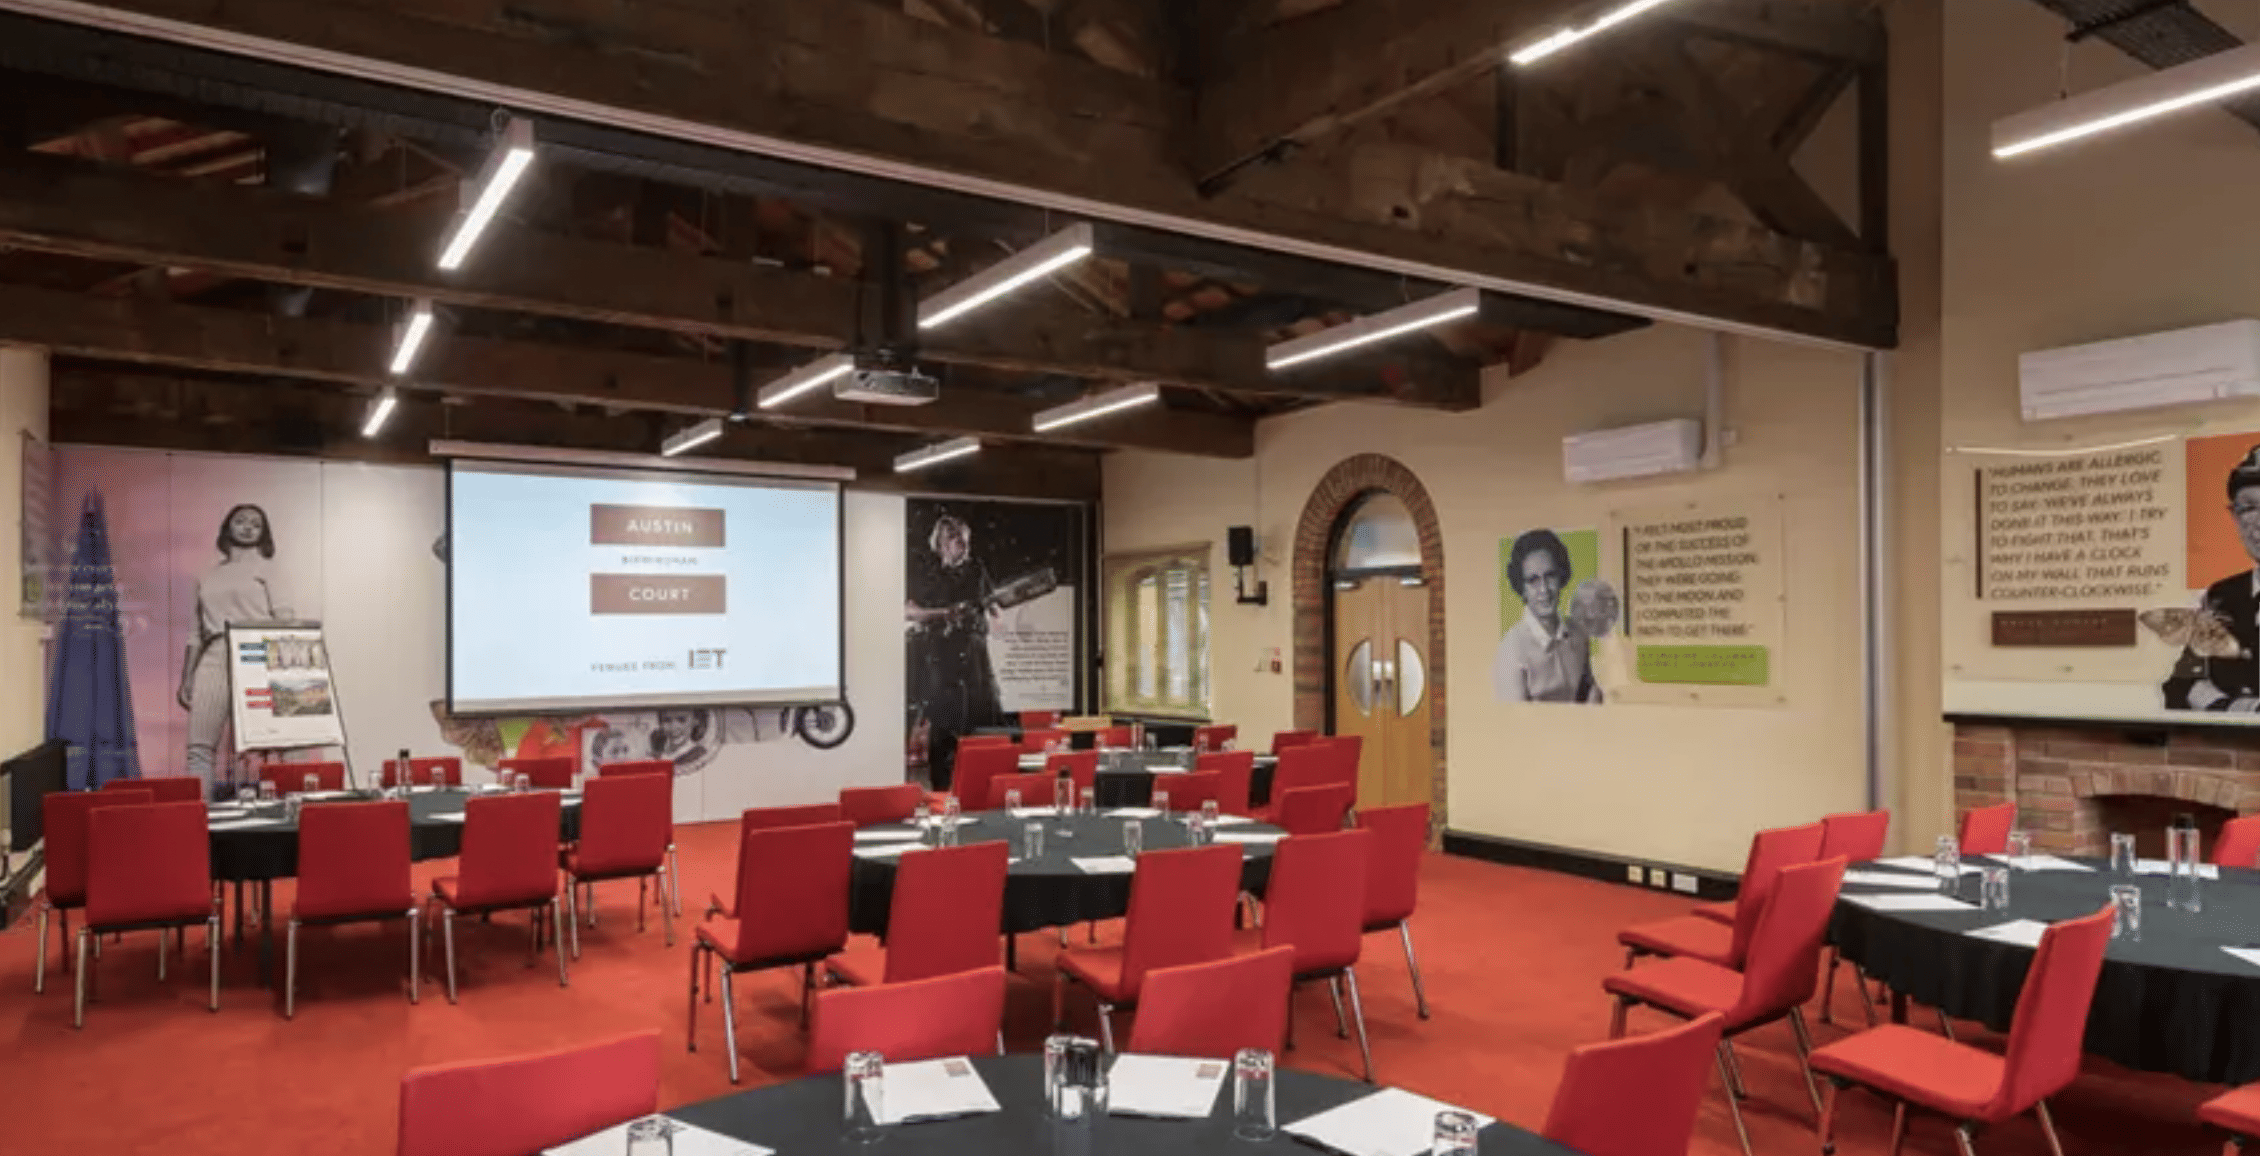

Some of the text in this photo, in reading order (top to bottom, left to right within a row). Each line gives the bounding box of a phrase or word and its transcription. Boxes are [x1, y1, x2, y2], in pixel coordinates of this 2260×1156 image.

[2057, 459, 2084, 473] ARE
[2087, 451, 2161, 469] ALLERGIC
[1990, 482, 2008, 496] TO
[2081, 473, 2117, 488] THEY
[2120, 469, 2161, 485] LOVE
[1990, 500, 2008, 513] TO
[2091, 489, 2153, 505] ALWAYS
[626, 518, 693, 534] AUSTIN
[1991, 516, 2032, 530] DONE
[2034, 514, 2047, 527] IT
[2052, 511, 2084, 526] THIS
[2140, 507, 2168, 521] TRY
[1655, 541, 1674, 552] THE
[1990, 534, 2008, 548] TO
[2012, 532, 2052, 547] FIGHT
[1990, 551, 2024, 564] WHY
[2034, 548, 2070, 563] HAVE
[2075, 548, 2085, 562] A
[2090, 546, 2143, 561] CLOCK
[1991, 563, 2170, 582] ON MY WALL THAT RUNS
[629, 587, 690, 601] COURT
[1708, 607, 1730, 619] THE
